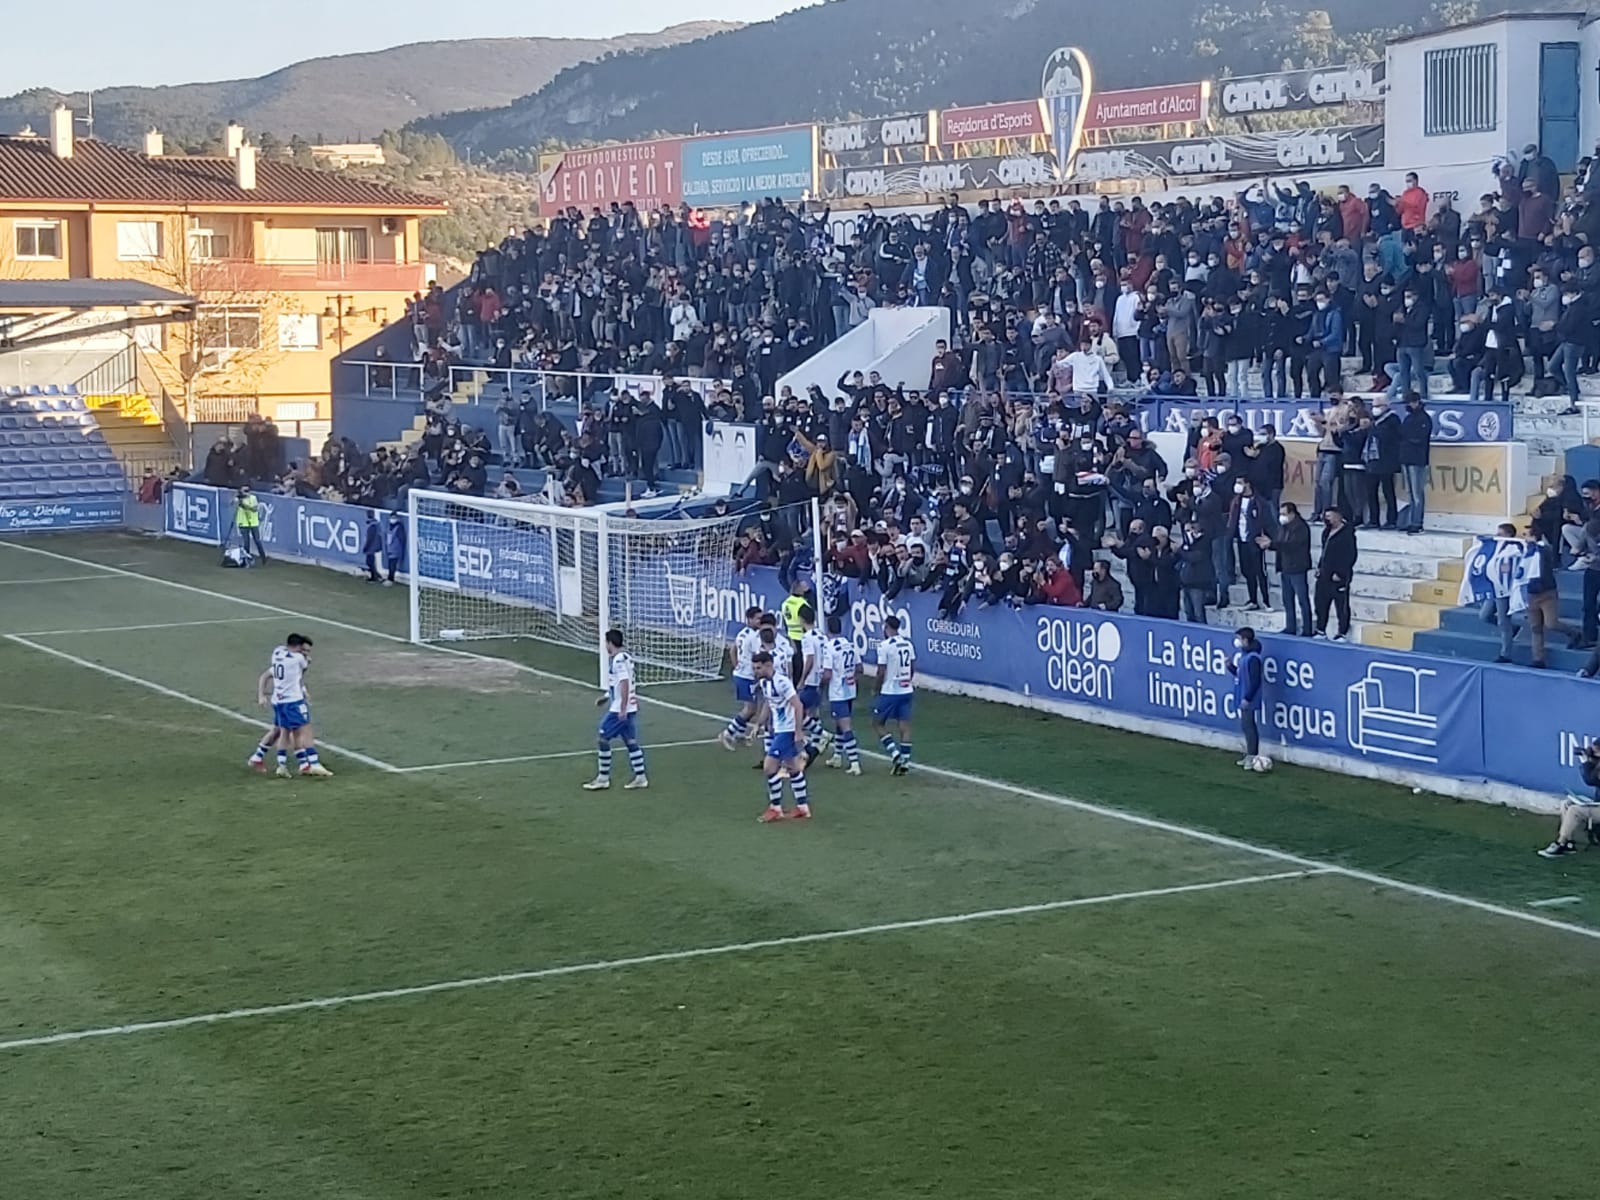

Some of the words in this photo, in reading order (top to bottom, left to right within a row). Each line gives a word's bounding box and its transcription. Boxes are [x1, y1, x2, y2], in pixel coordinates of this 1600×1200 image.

[991, 112, 1033, 131] d'Esports
[1096, 99, 1157, 124] Ajuntament
[1160, 94, 1196, 114] d'Alcoi
[546, 161, 674, 203] BENAVENT
[297, 505, 360, 554] ficxa
[927, 617, 981, 640] CORREDURÍA
[842, 649, 855, 669] 22
[898, 649, 910, 668] 12
[928, 638, 940, 653] DE
[941, 640, 982, 660] SEGUROS
[1037, 616, 1097, 676] aqua
[1148, 631, 1176, 667] La
[1182, 636, 1226, 676] tela
[1285, 659, 1315, 690] se
[272, 663, 285, 681] 10
[1047, 655, 1112, 700] clean
[1148, 671, 1217, 718] limpia
[1274, 702, 1337, 740] agua
